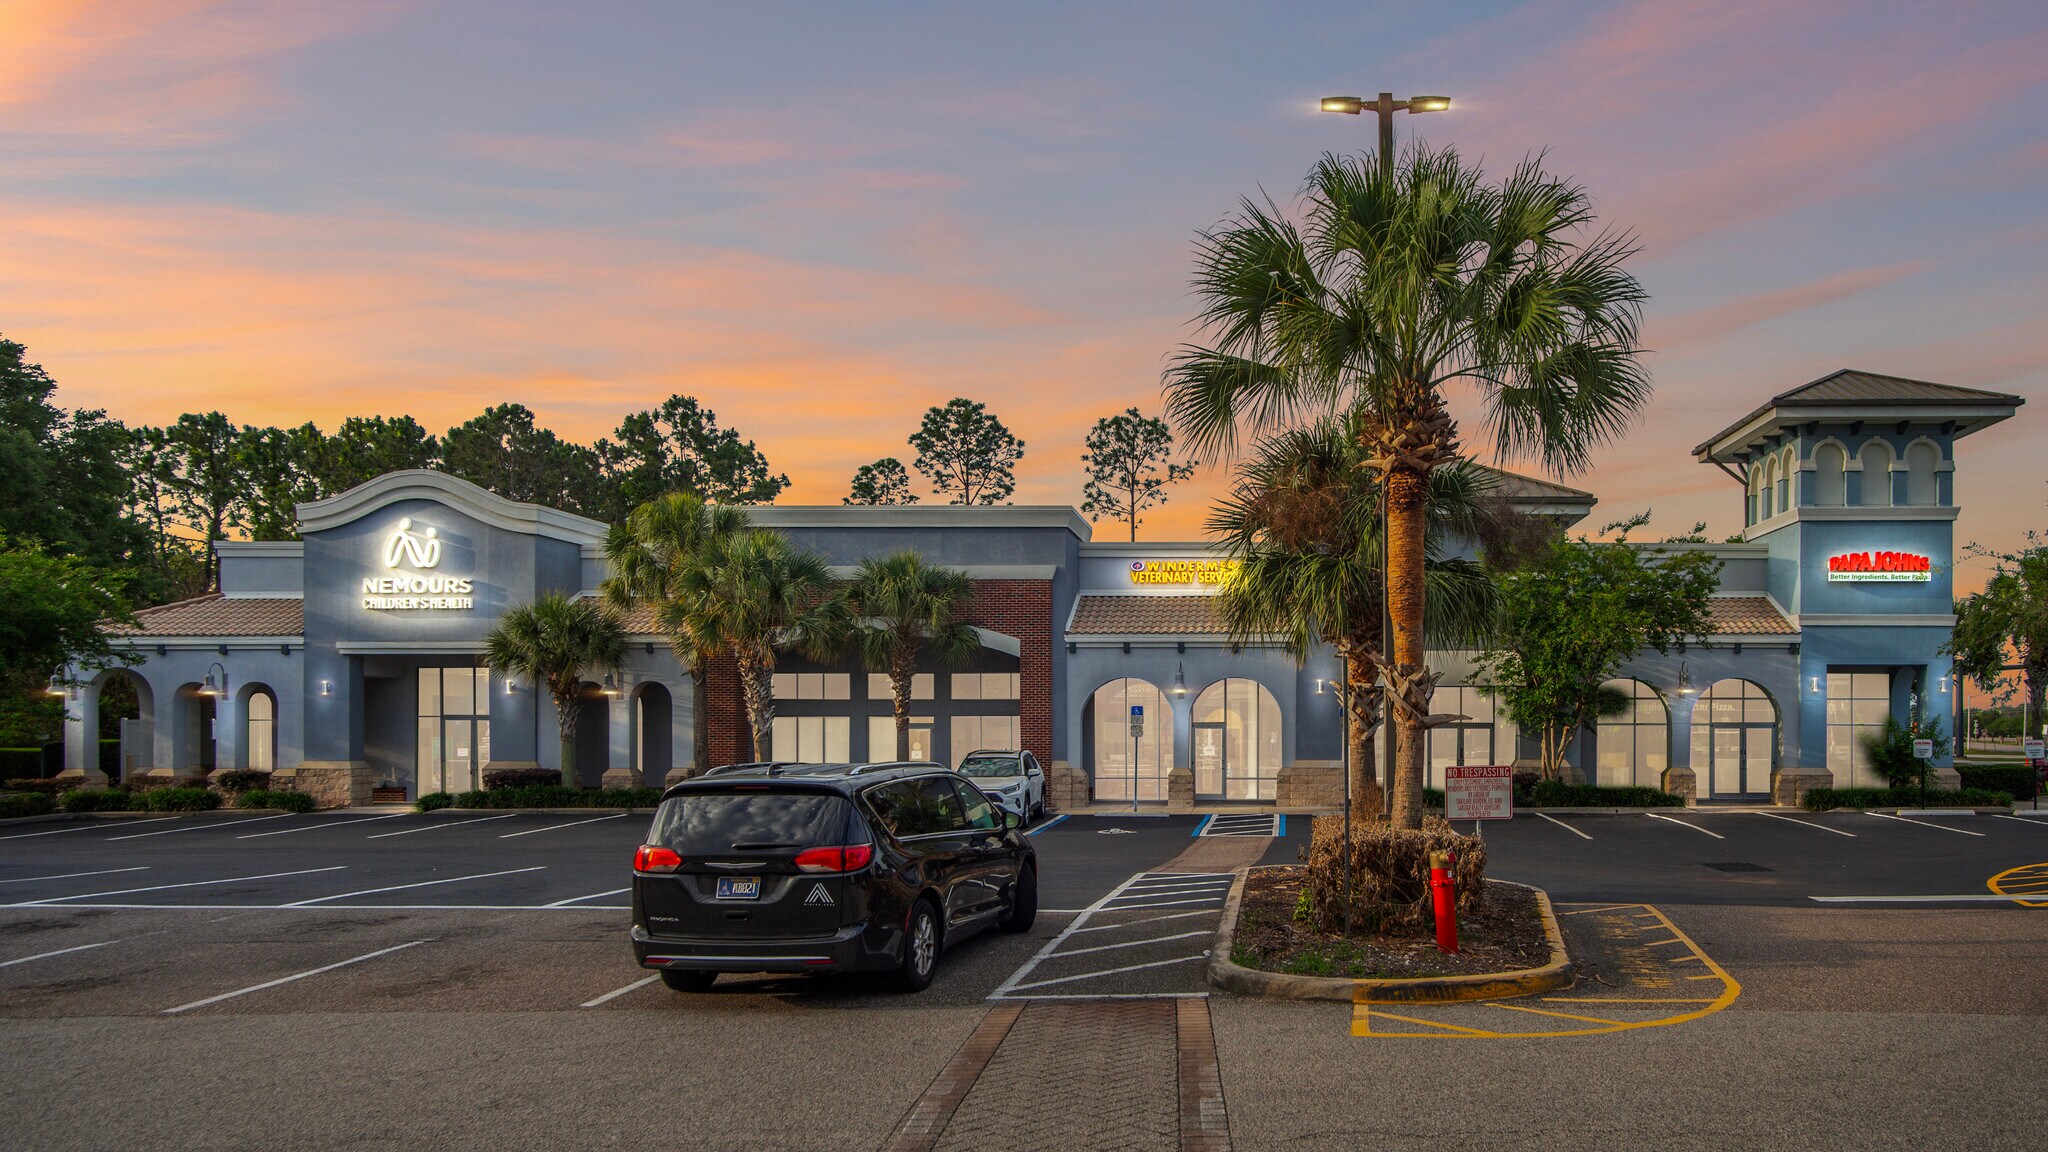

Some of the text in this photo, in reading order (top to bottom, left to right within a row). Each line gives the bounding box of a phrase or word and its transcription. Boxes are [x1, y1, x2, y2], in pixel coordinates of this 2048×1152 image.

[1829, 551, 1872, 571] PAPA
[1131, 571, 1195, 583] VETERINARY
[363, 577, 474, 594] NEMOURS
[363, 597, 474, 609] CHILDREN'S HEALTH
[1448, 768, 1509, 778] NO TRESPASSING
